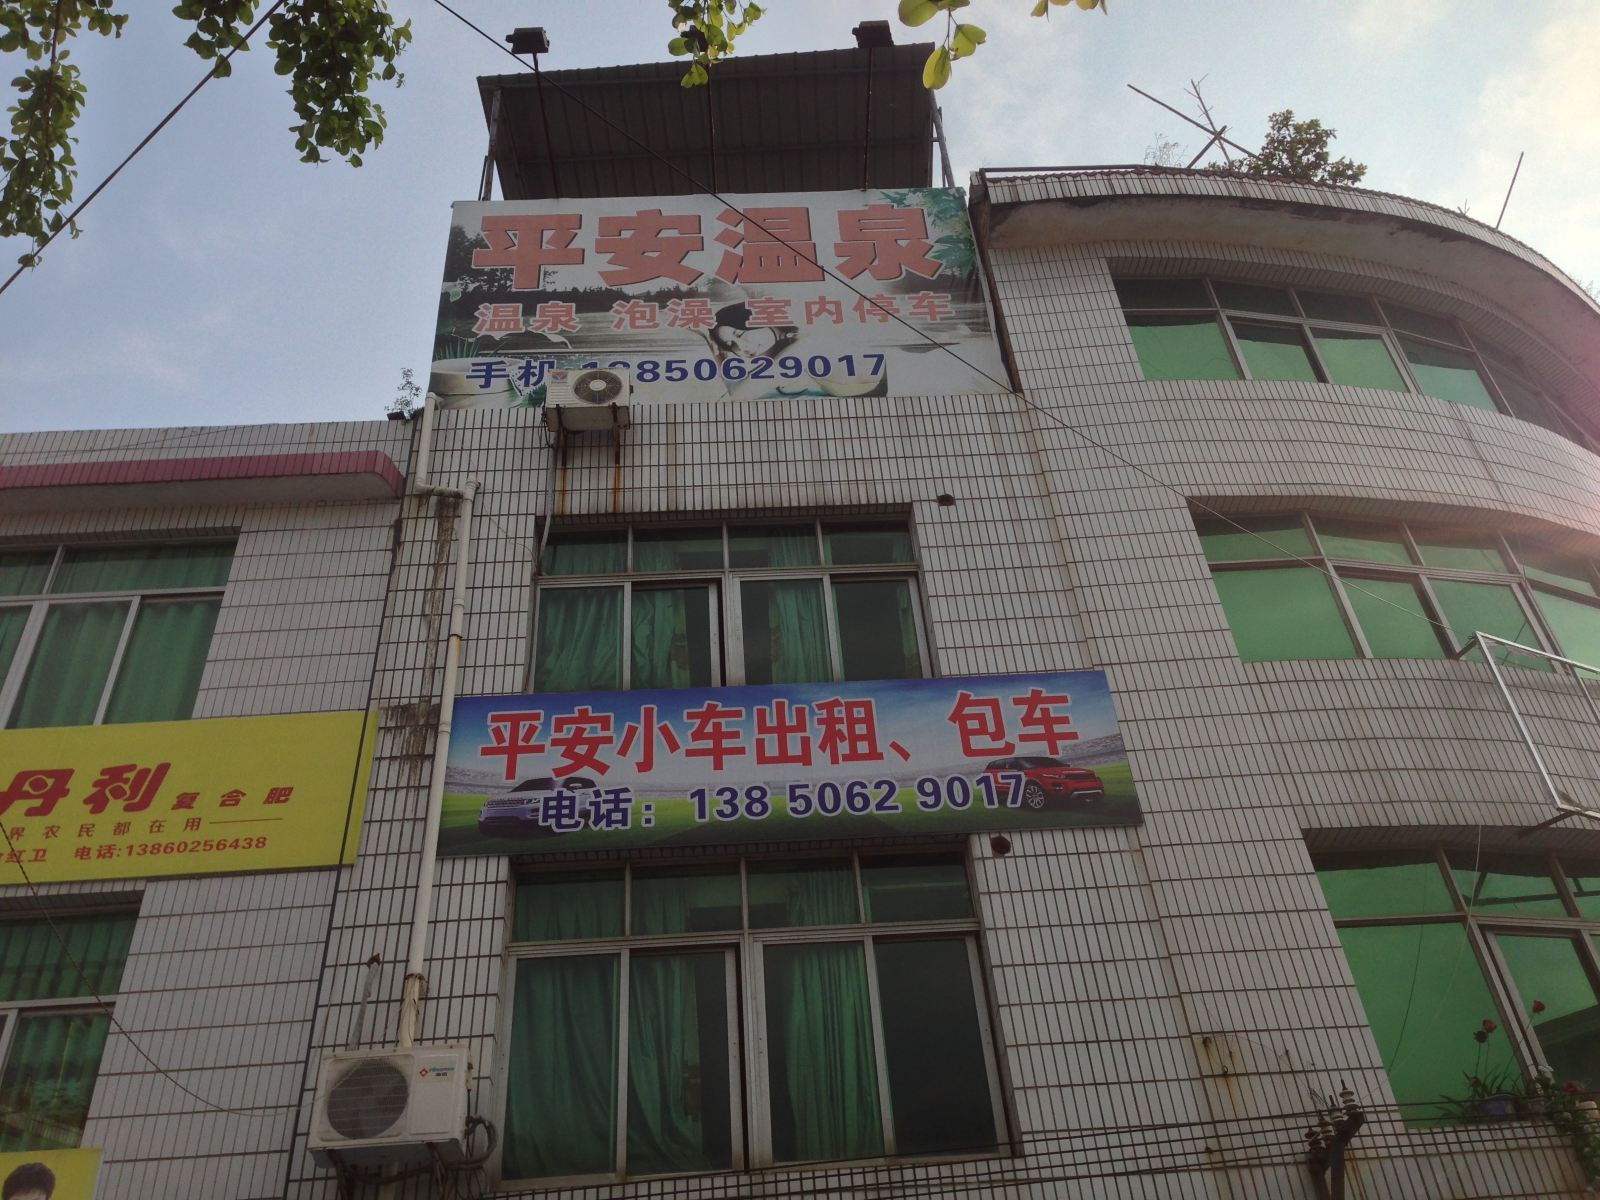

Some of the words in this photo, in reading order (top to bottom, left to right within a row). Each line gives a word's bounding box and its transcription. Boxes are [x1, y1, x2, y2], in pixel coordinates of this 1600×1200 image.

[472, 204, 944, 289] 平安温泉
[473, 301, 580, 333] 温泉
[612, 299, 717, 331] 泡澡
[748, 292, 954, 326] 室内停车
[466, 359, 556, 388] 手机
[171, 787, 294, 811] 复合肥
[541, 786, 652, 830] 电话：
[689, 785, 769, 820] 138
[788, 779, 900, 816] 5062
[916, 772, 1025, 809] 9017
[0, 848, 47, 864] 红卫
